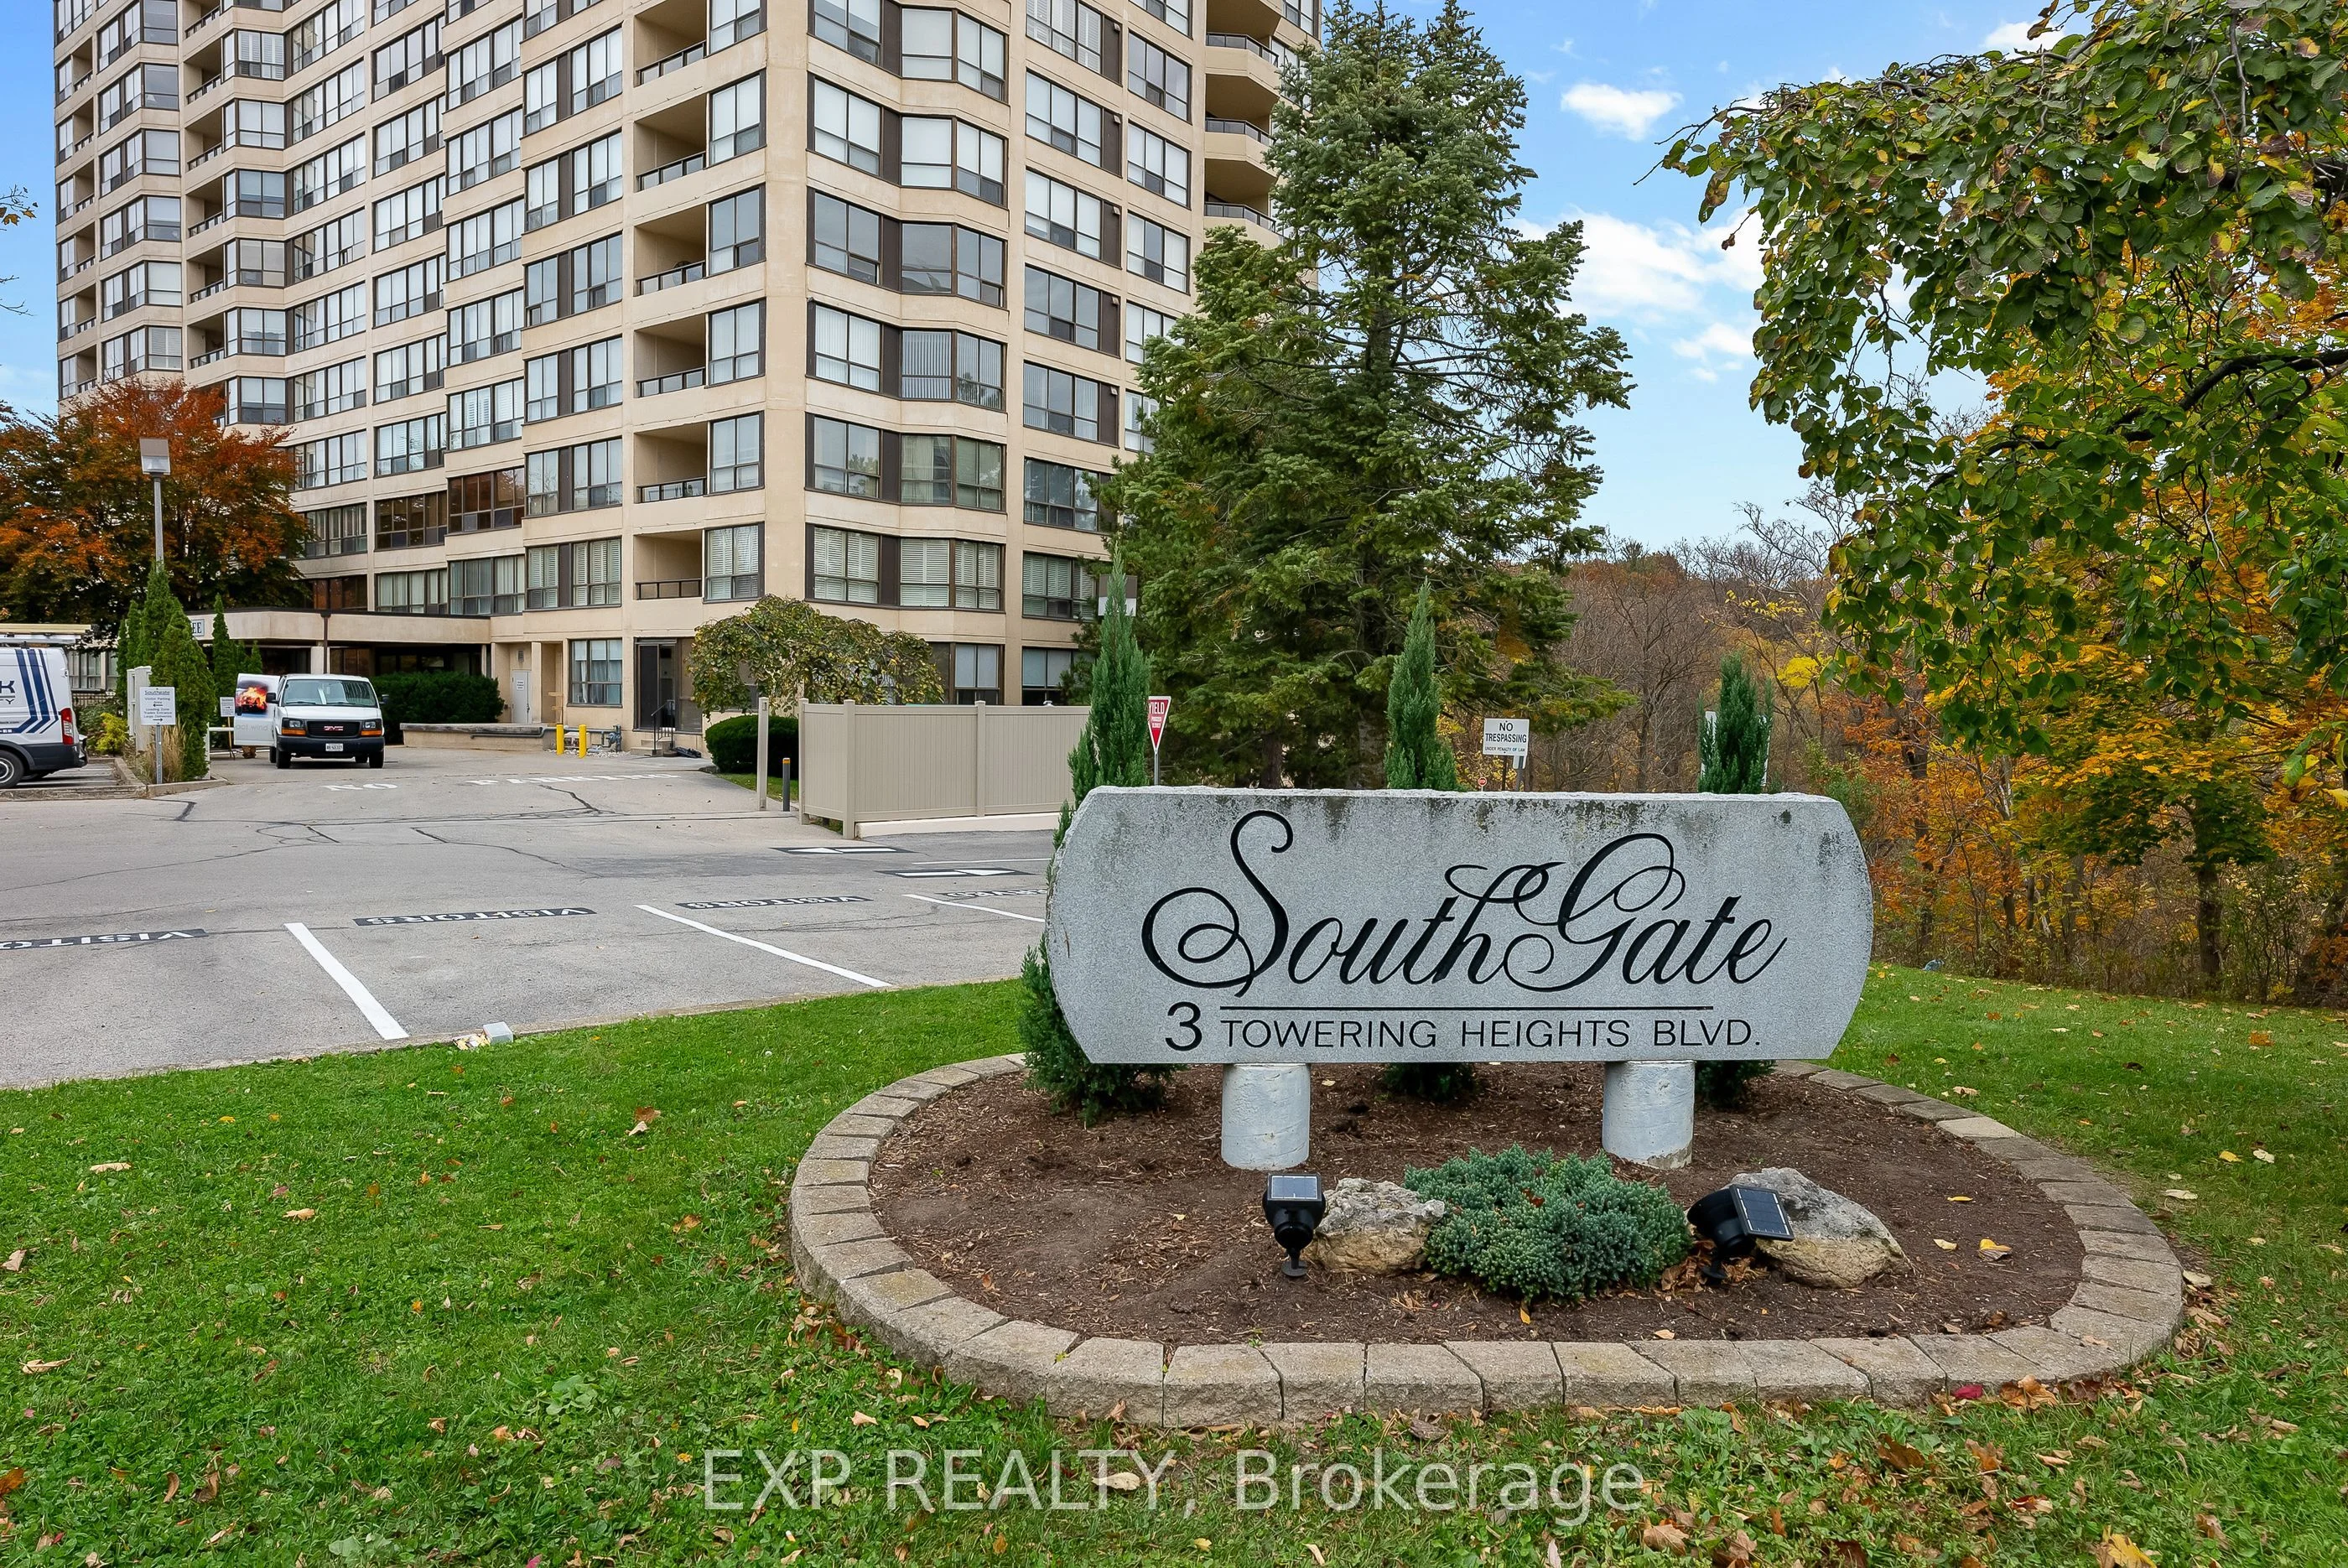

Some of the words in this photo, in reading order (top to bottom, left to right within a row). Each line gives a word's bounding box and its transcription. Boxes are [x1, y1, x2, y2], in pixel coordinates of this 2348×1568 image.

[1148, 701, 1165, 714] YIELD
[1499, 722, 1514, 731] NO
[1485, 733, 1527, 743] TRESPASSING
[320, 782, 398, 792] NO
[688, 896, 869, 909] VISITORS
[366, 907, 589, 926] VISITORS
[1166, 1003, 1203, 1051] 3
[1221, 1020, 1437, 1049] TOWERING
[1462, 1020, 1631, 1048] HEIGHTS
[1654, 1019, 1761, 1047] BLVD.
